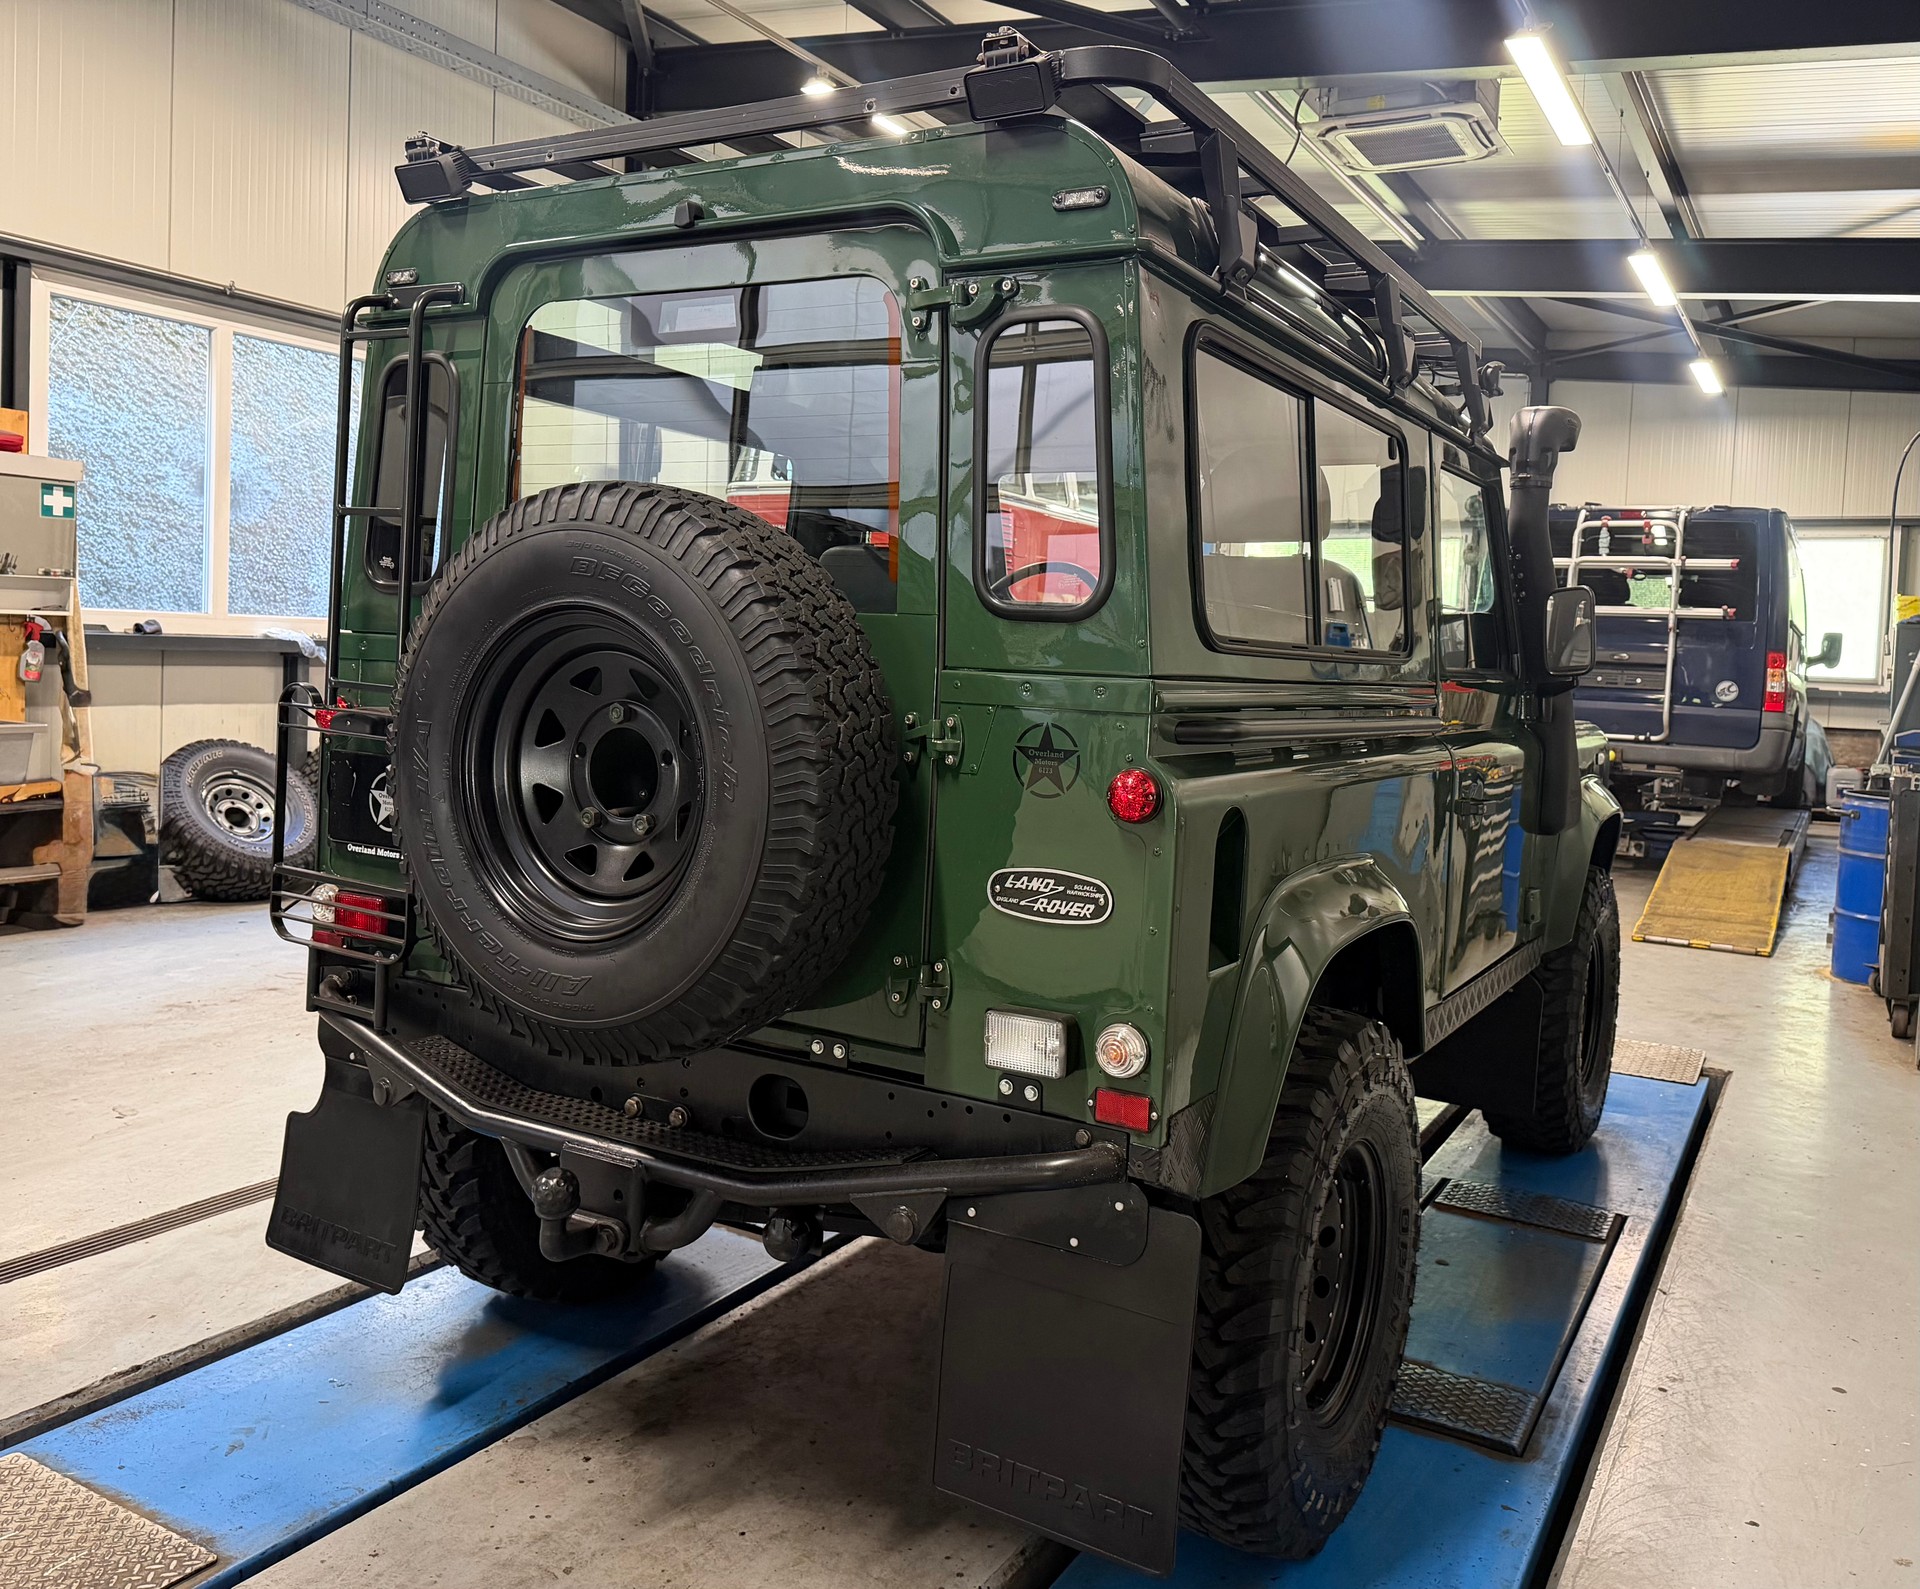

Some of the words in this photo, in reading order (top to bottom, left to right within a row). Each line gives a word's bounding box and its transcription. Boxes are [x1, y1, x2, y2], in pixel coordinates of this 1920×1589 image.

[594, 543, 650, 573] Champion
[569, 556, 738, 803] BFGoodrich
[1028, 749, 1064, 759] Overland
[1034, 758, 1058, 766] Motors
[347, 843, 376, 855] Overland
[376, 848, 400, 859] Motors
[1004, 874, 1058, 892] LAND
[1033, 898, 1095, 918] ROVER
[280, 1205, 398, 1264] BRITPART
[1387, 1206, 1411, 1336] OPEN
[947, 1437, 1155, 1537] BRITPART
